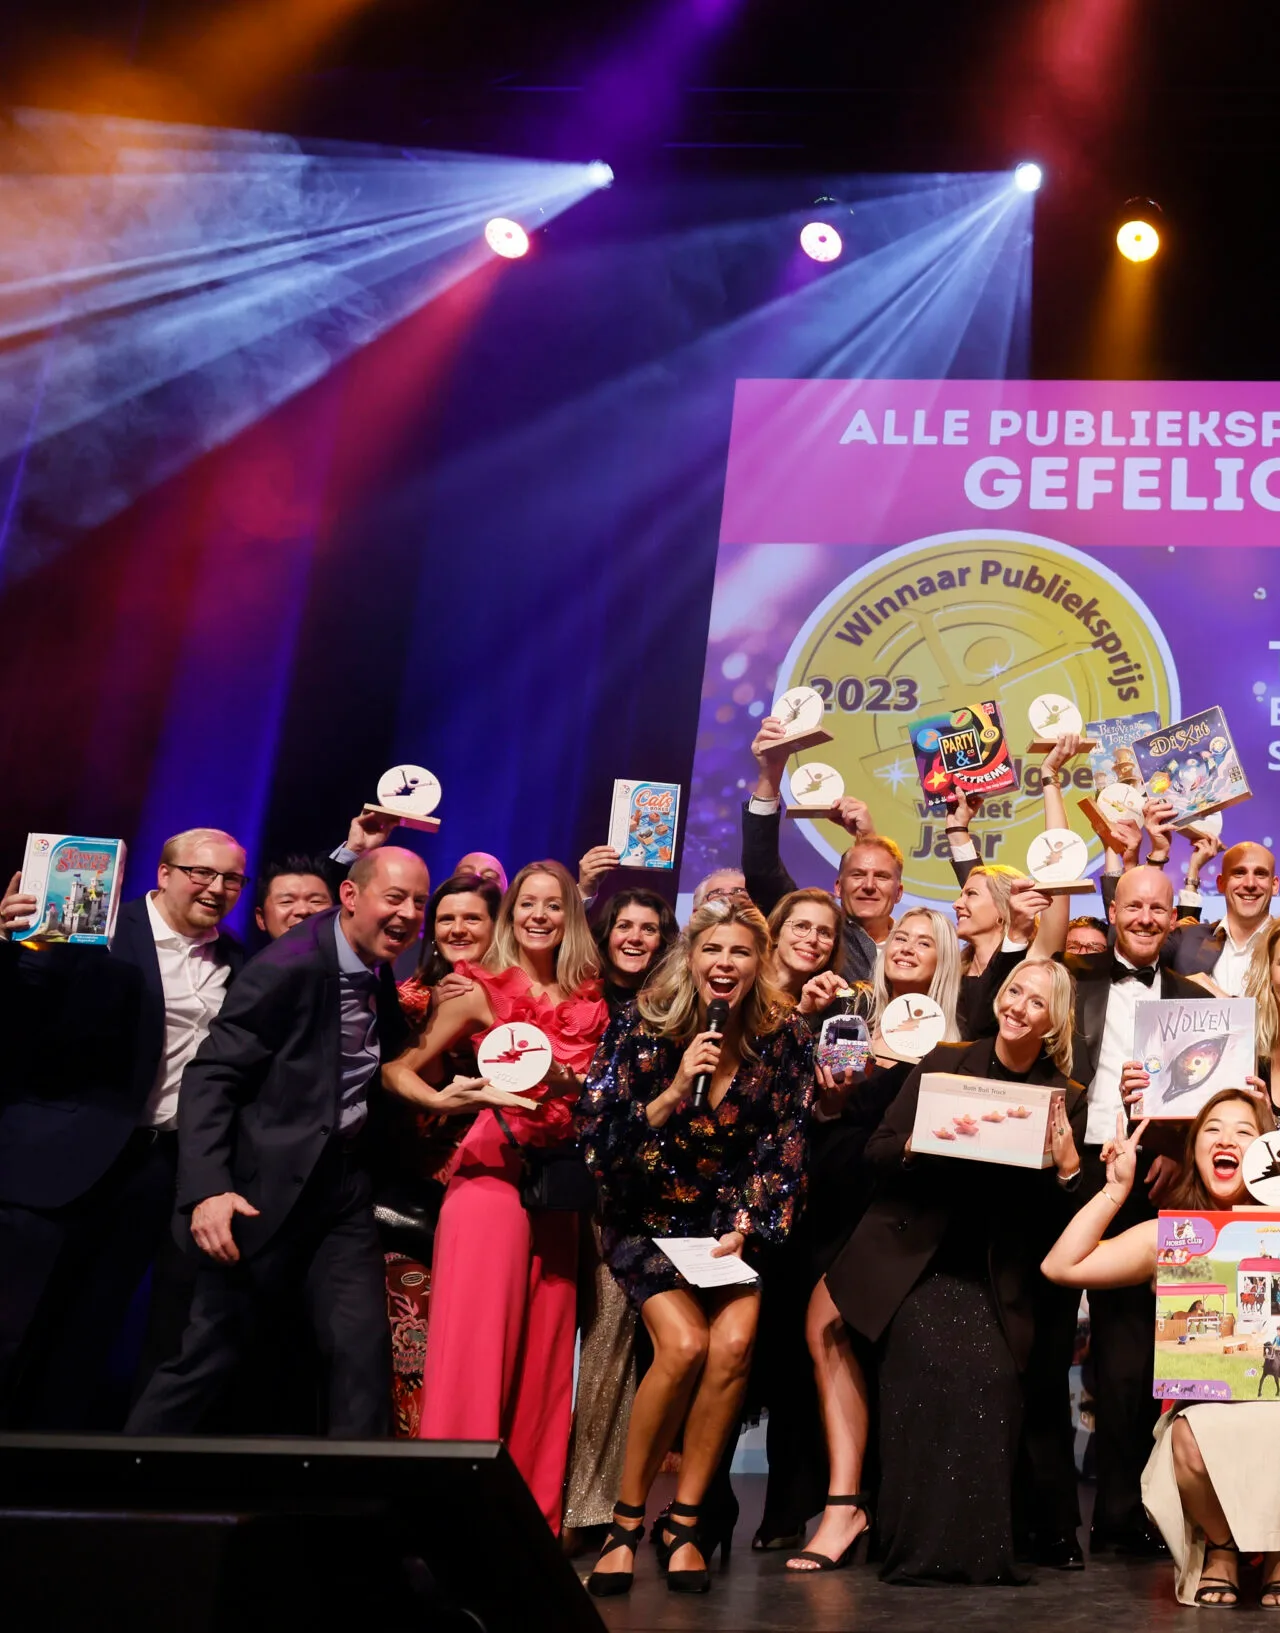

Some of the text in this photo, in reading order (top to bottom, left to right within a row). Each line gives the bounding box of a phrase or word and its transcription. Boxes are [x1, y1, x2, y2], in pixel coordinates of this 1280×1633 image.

[839, 409, 970, 445] ALLE
[835, 560, 1144, 702] Winnaar Publieksprijs
[810, 678, 918, 712] 2023
[942, 732, 974, 755] PARTY
[954, 763, 1010, 784] EXTREME
[635, 789, 674, 808] Cats
[1158, 1006, 1231, 1042] WOLVEN
